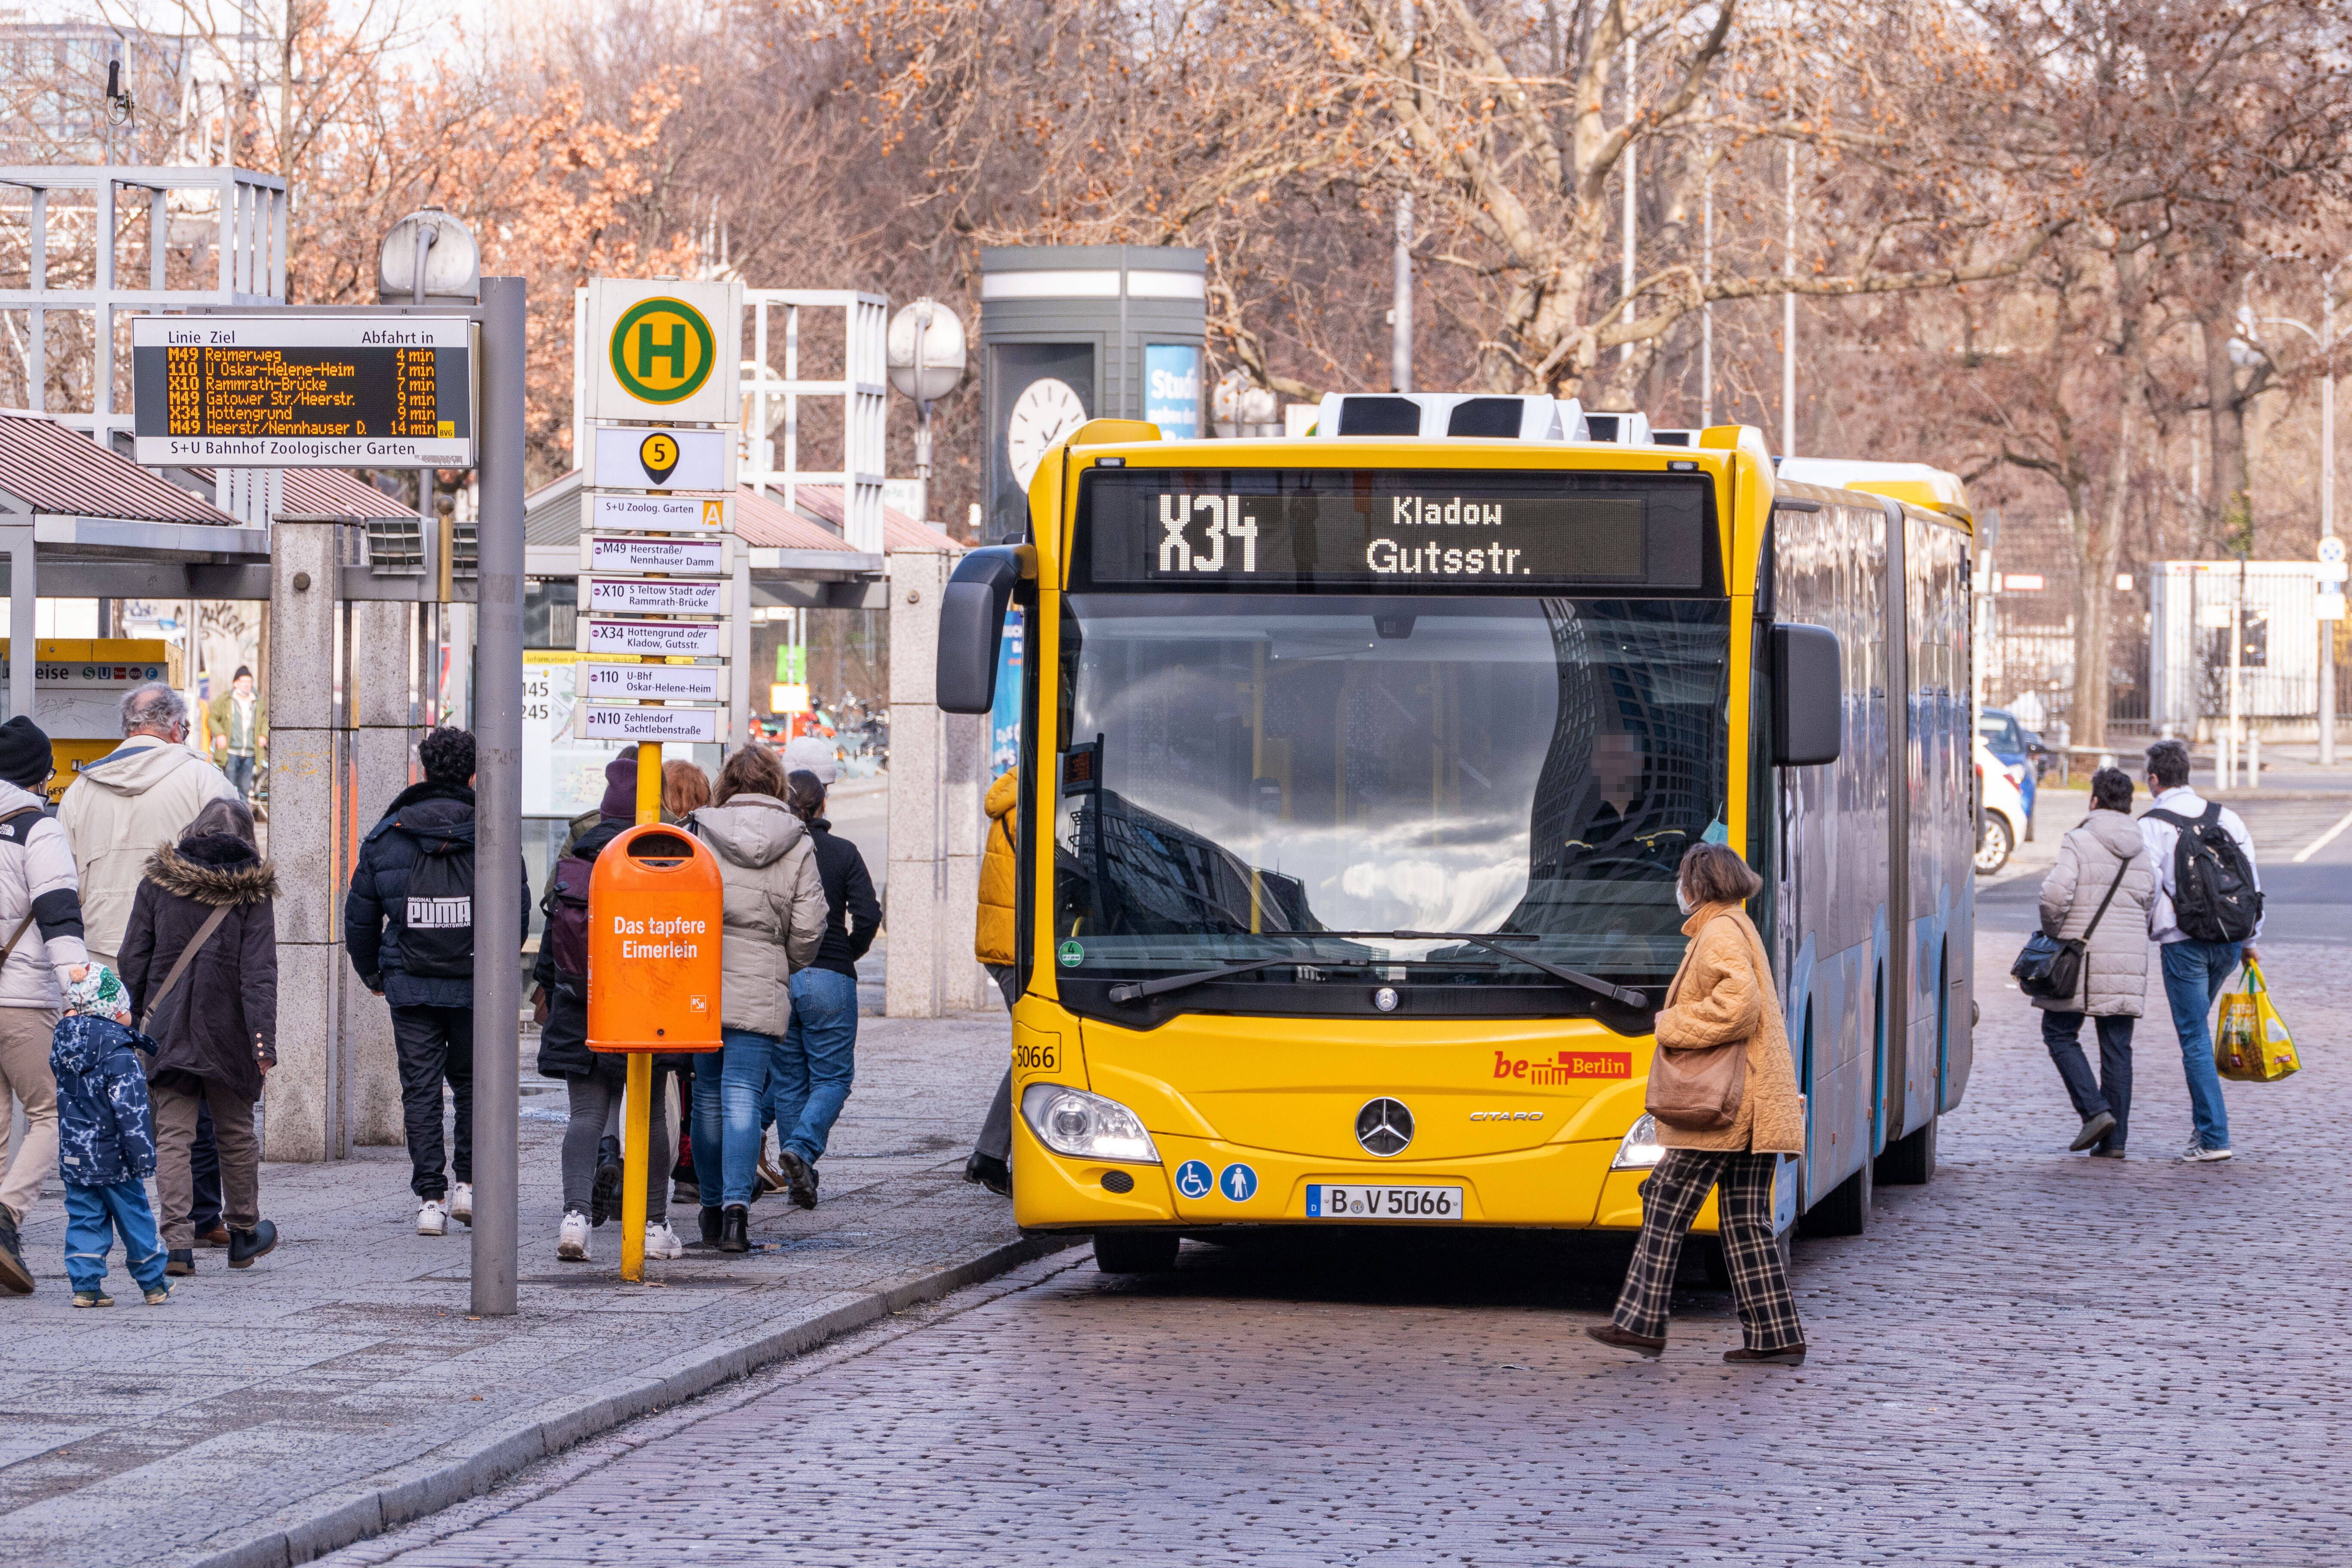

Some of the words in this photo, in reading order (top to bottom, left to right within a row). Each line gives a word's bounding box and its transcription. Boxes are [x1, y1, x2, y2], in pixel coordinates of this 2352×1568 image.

[169, 331, 201, 343] Linie
[211, 331, 235, 343] Ziel
[362, 331, 416, 343] Abfahrt
[422, 331, 434, 343] in
[168, 347, 199, 361] M49
[205, 347, 281, 363] Reimerweg
[396, 348, 405, 362] 4
[408, 348, 434, 362] min
[638, 323, 686, 378] H
[168, 362, 197, 376] 110
[205, 362, 214, 376] U
[221, 362, 354, 376] Oskar-Helene-Heim
[396, 362, 405, 377] 7
[409, 362, 434, 377] min
[169, 377, 199, 390] X10
[206, 377, 327, 391] Rammrath-Brücke
[397, 377, 405, 391] 7
[409, 377, 434, 391] min
[169, 391, 199, 405] M49
[207, 391, 264, 405] Gatower
[271, 391, 355, 405] Str/Heerstr.
[397, 392, 406, 405] 9
[410, 392, 435, 406] min
[170, 406, 200, 420] X34
[207, 406, 292, 421] Hottengrund
[398, 406, 406, 420] 9
[410, 406, 435, 420] min
[170, 420, 200, 434] M49
[207, 420, 350, 435] Heerstr/Nennhauser
[356, 420, 367, 435] D.
[390, 420, 406, 435] 14
[410, 421, 435, 435] min
[171, 441, 200, 454] S+U
[206, 441, 265, 454] Bahnhof
[271, 441, 361, 458] Zoologischer
[367, 442, 415, 455] Garten
[654, 444, 665, 462] 5
[606, 502, 624, 511] S+U
[627, 503, 660, 514] Zoolog.
[663, 505, 693, 514] Garten
[704, 505, 722, 525] A
[1159, 494, 1257, 572] X34
[1393, 496, 1502, 525] Kladow
[603, 543, 626, 554] M49
[631, 545, 683, 555] Heerstraße/
[1367, 539, 1531, 574] Gutsstr.
[631, 556, 683, 566] Nennhauser
[686, 558, 714, 566] Damm
[602, 585, 624, 597] X10
[630, 586, 634, 594] S
[638, 586, 666, 595] Teltow
[669, 587, 693, 595] Stadt
[696, 587, 716, 596] oder
[630, 596, 708, 607] Rammrath-Brücke
[600, 627, 624, 639] X34
[628, 628, 684, 639] Hottengrund
[687, 629, 707, 638] oder
[628, 639, 662, 649] Kladow,
[666, 640, 699, 649] Gutsstr.
[600, 671, 619, 683] 110
[627, 672, 652, 681] U-Bhf
[627, 682, 711, 693] Oskar-Helene-Heim
[598, 712, 620, 724] N10
[625, 714, 674, 723] Zehlendorf
[625, 724, 701, 735] Sachtlebenstraße
[407, 901, 471, 923] PUMA
[615, 916, 644, 934] Das
[649, 916, 705, 938] tapfere
[623, 940, 697, 958] Eimerlein
[1068, 943, 1075, 953] 4
[692, 998, 704, 1009] BSR
[1017, 1045, 1054, 1068] 5066
[1494, 1051, 1528, 1078] be
[1572, 1058, 1625, 1075] Berlin
[1470, 1112, 1544, 1121] CITARO
[1332, 1189, 1347, 1213] B
[1366, 1190, 1381, 1213] V
[1388, 1190, 1451, 1214] 5066
